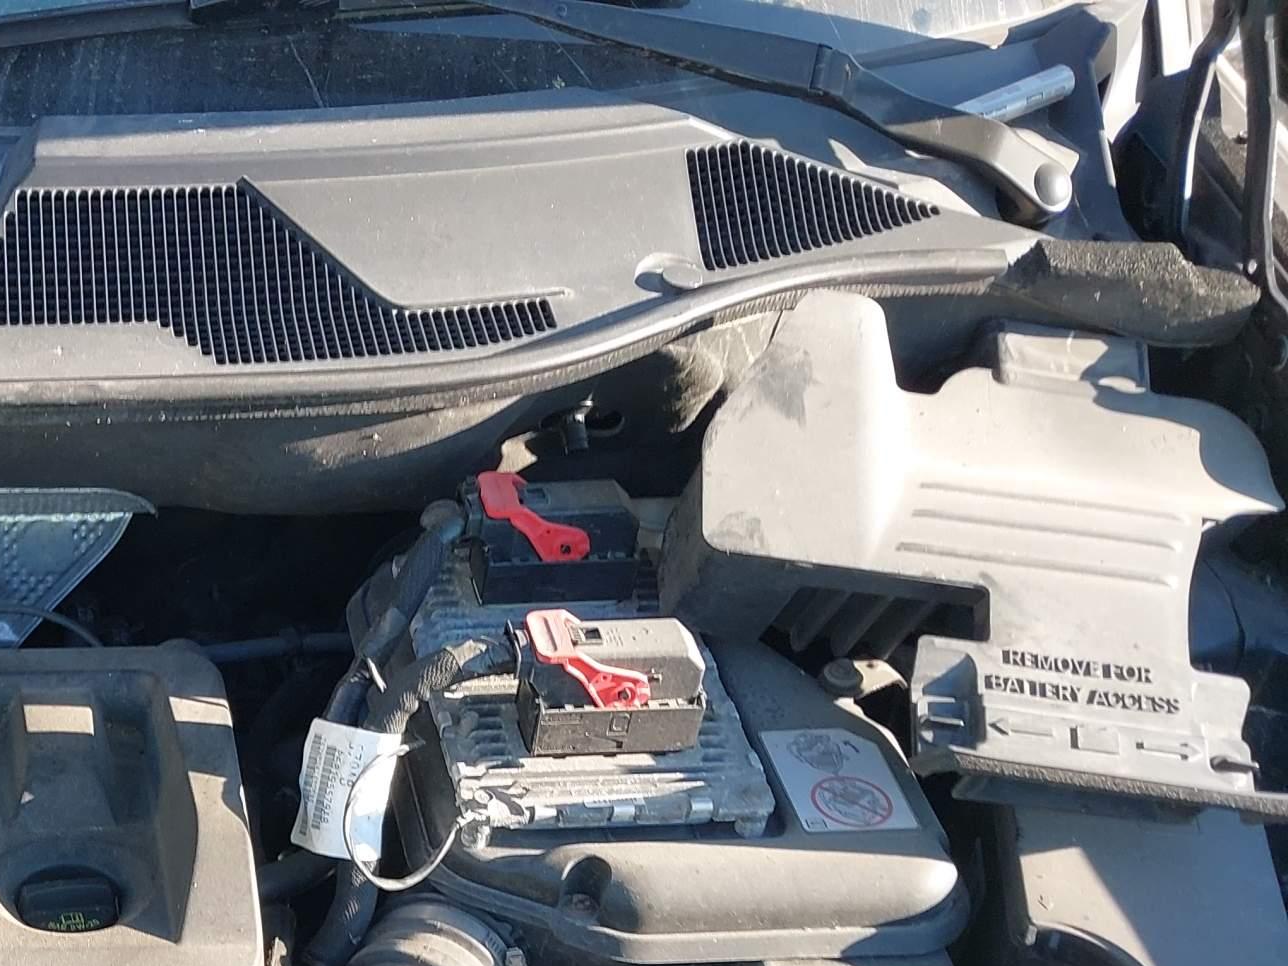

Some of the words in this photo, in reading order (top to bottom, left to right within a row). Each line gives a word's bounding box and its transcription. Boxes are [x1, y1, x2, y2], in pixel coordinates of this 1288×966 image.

[1002, 649, 1101, 678] REMOVE
[1104, 662, 1153, 684] FOR
[984, 674, 1082, 705] BATTERY
[1087, 689, 1181, 715] ACCESS
